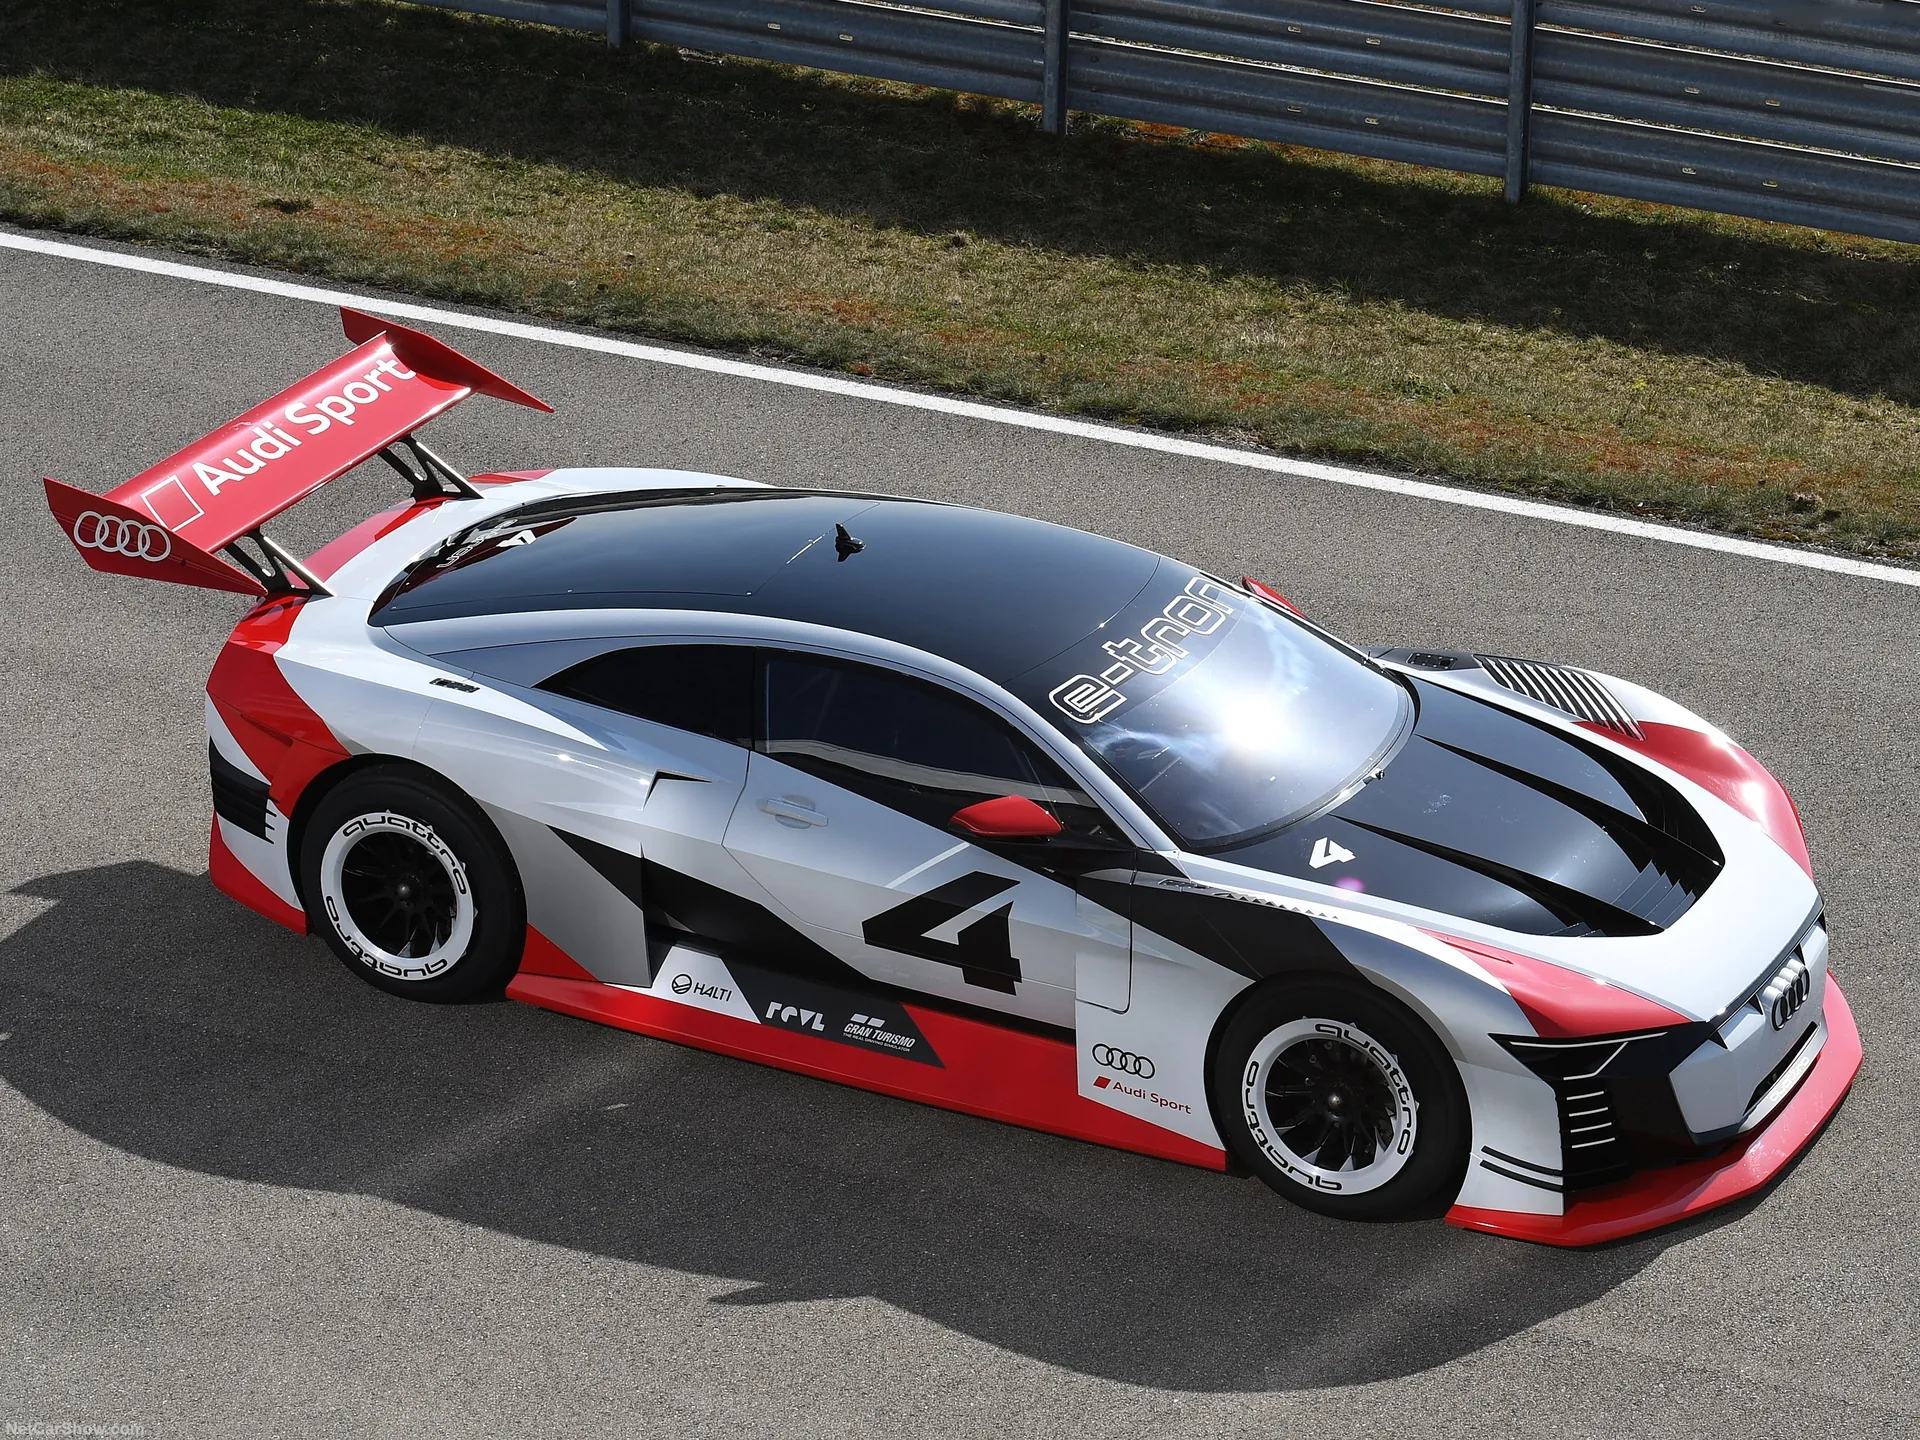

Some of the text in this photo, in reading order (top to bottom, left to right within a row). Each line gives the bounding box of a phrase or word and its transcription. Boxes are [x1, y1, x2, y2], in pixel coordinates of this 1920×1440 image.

[190, 358, 417, 497] Audi Sport
[1048, 576, 1247, 724] e-tron
[342, 815, 467, 895] quattro
[1309, 837, 1356, 870] 4
[325, 895, 448, 977] quattro
[861, 870, 1023, 996] 4
[693, 982, 732, 1002] HALTI
[843, 1023, 916, 1048] GRAN TURISMO
[852, 1034, 864, 1042] REAL
[864, 1037, 884, 1046] DRIVING
[1113, 1081, 1192, 1115] Audi Sport
[1245, 1061, 1343, 1191] quattro
[1315, 1023, 1411, 1156] quattro
